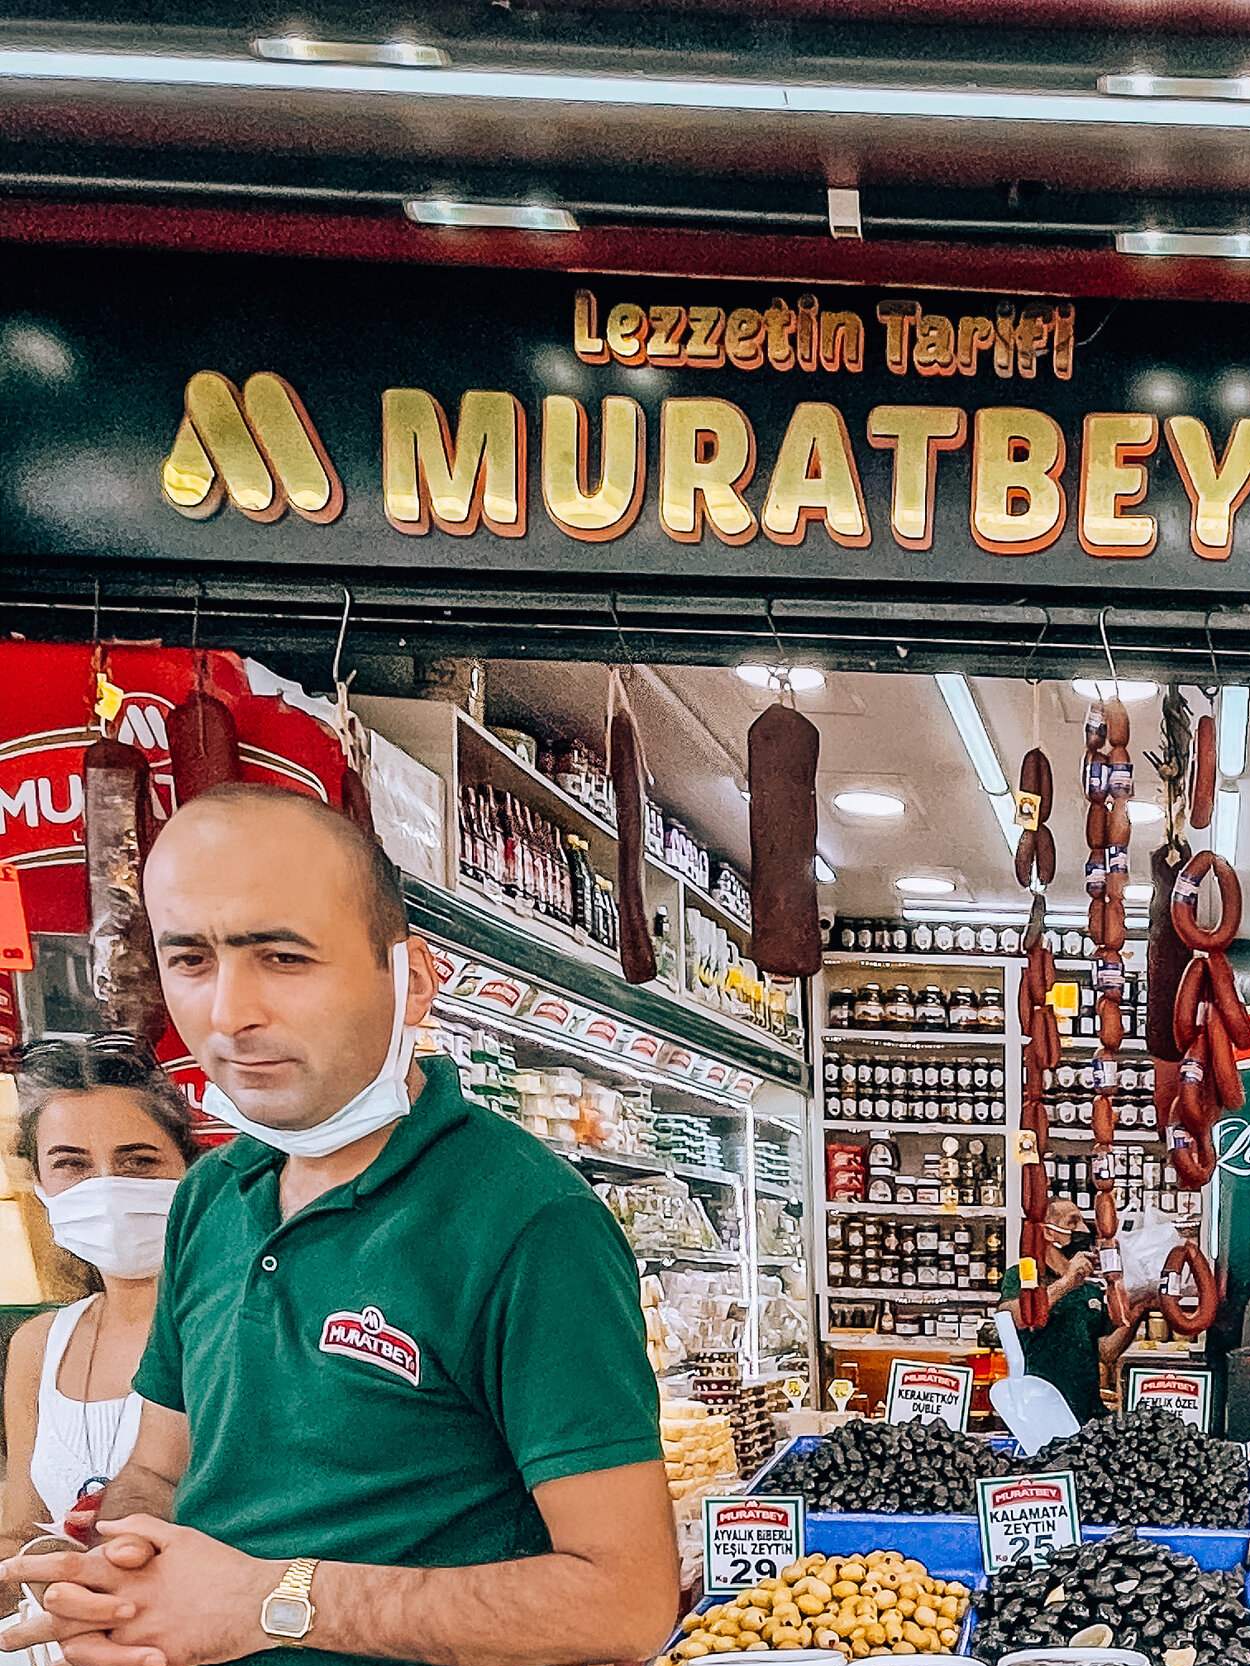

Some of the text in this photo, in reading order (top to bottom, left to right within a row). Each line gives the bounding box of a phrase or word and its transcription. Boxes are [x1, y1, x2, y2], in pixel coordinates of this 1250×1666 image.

[575, 289, 864, 373] Lezzetin
[329, 1325, 413, 1369] MURATBEY
[903, 1373, 957, 1388] MURATBEY
[1143, 1380, 1196, 1392] MURATBEY
[996, 1486, 1061, 1503] MURATBEY
[720, 1509, 785, 1522] MURATBEY
[990, 1505, 1068, 1523] KALAMATA
[714, 1529, 754, 1541] AYVALIK
[1008, 1534, 1053, 1561] 25
[715, 1558, 777, 1585] Kg 29
